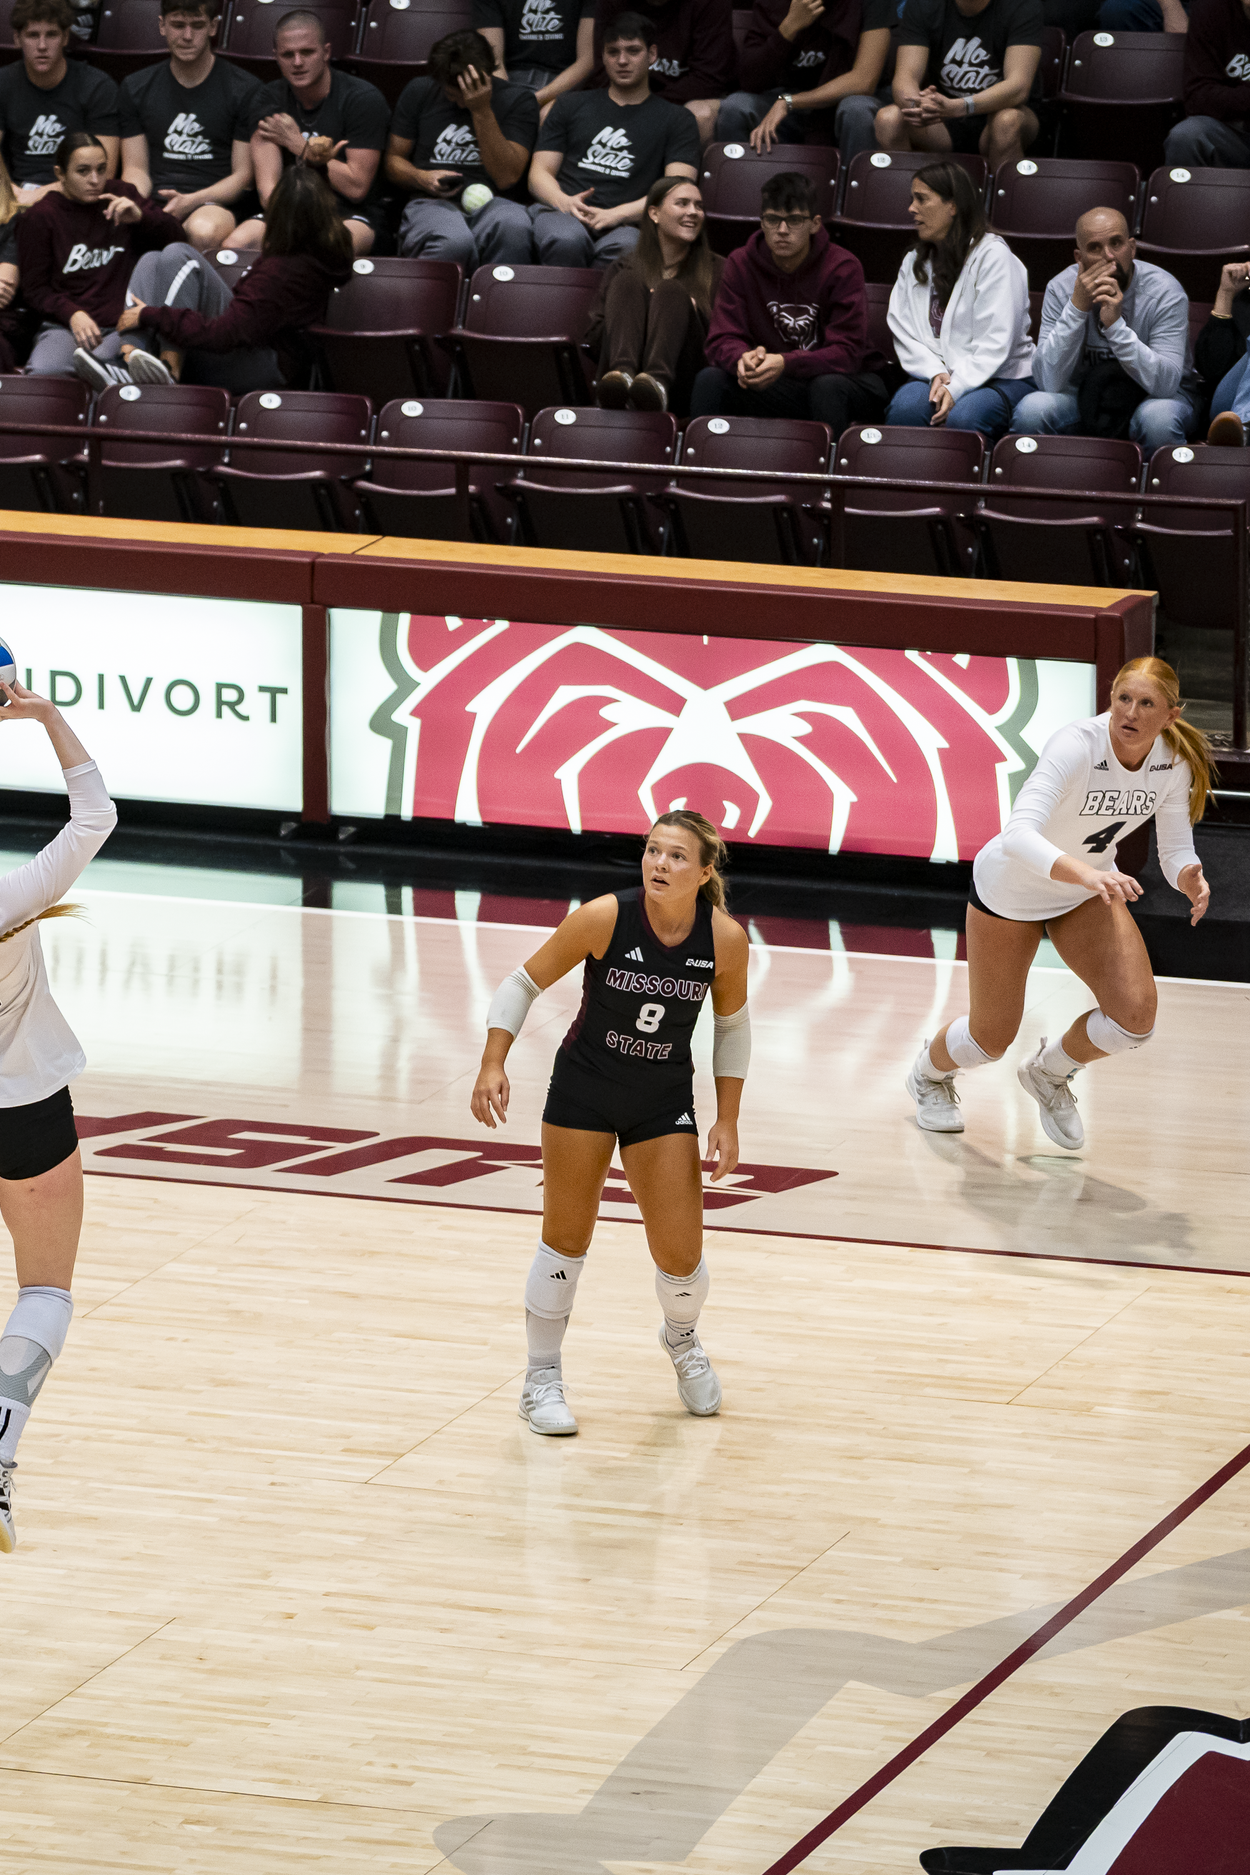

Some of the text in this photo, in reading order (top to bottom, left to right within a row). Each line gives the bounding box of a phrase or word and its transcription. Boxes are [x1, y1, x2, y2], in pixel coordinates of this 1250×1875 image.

[943, 36, 991, 65] Mo
[940, 63, 1001, 90] State
[29, 114, 67, 136] Mo
[167, 112, 204, 134] Mo
[436, 123, 477, 145] Mo
[25, 135, 66, 154] Stat
[164, 133, 212, 154] State
[591, 126, 633, 147] Mo
[433, 142, 482, 162] State
[582, 144, 635, 170] State
[1079, 790, 1157, 816] BEARS
[1082, 821, 1127, 853] 4
[605, 967, 709, 1001] MISSOURI
[635, 1003, 665, 1033] 8
[606, 1030, 672, 1060] STATE
